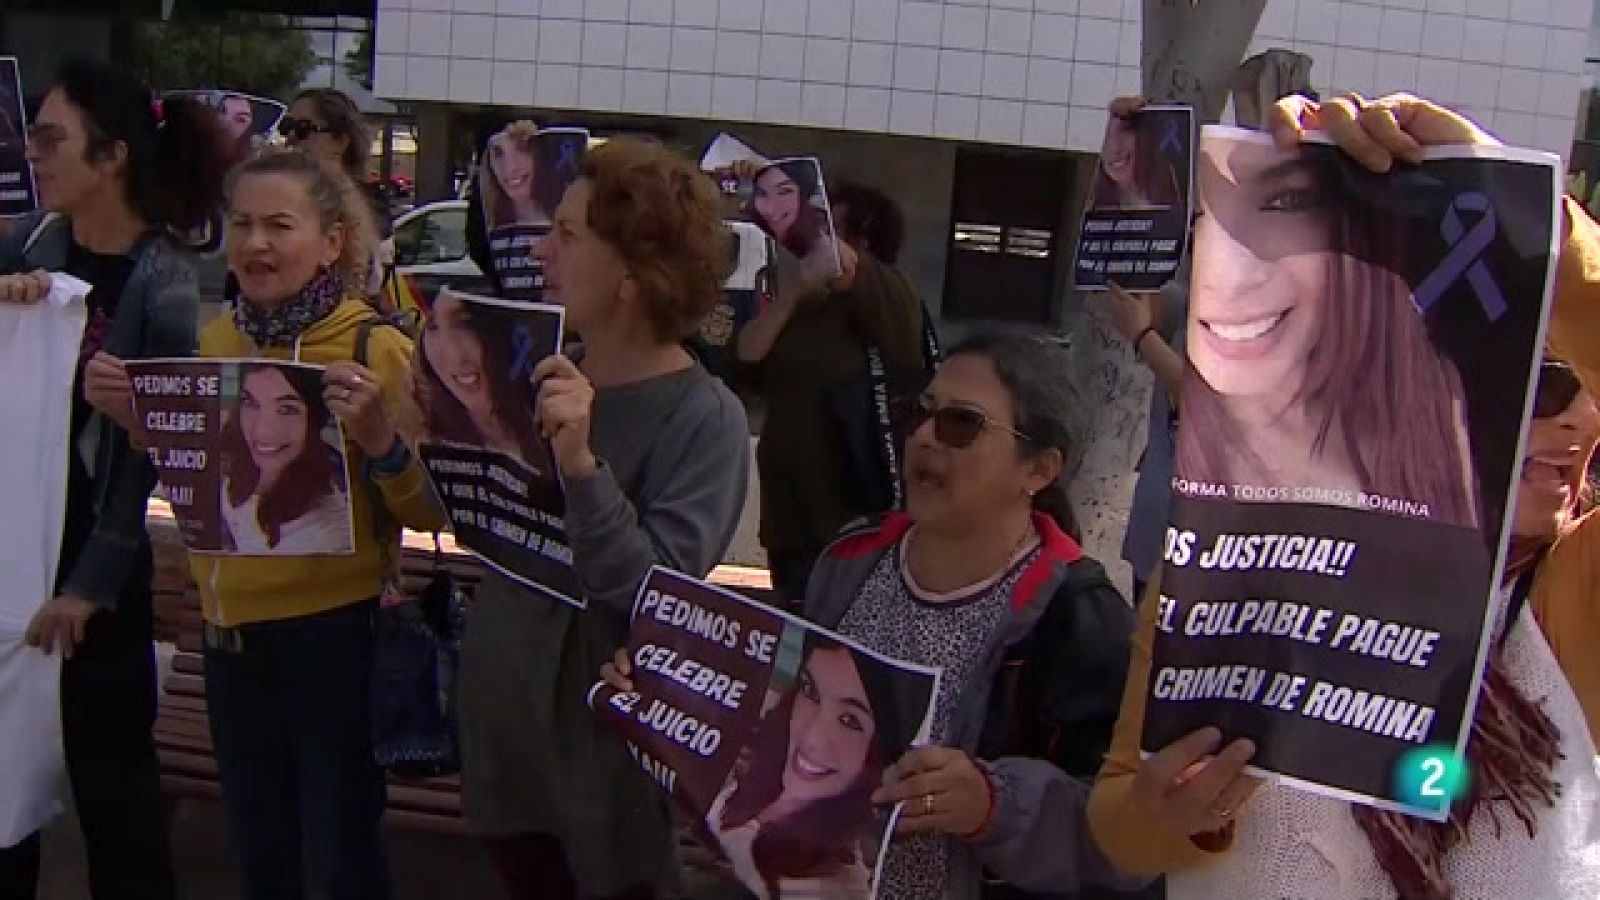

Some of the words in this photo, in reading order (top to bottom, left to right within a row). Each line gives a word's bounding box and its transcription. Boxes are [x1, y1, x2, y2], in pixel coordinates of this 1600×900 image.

[133, 374, 191, 395] PEDIMOS
[197, 376, 219, 396] SE
[147, 411, 206, 432] CELEBRE
[164, 449, 207, 470] JUICIO
[1232, 485, 1288, 500] TODOS
[1294, 487, 1353, 503] SOMOS
[1357, 492, 1430, 517] ROMINA
[1200, 533, 1356, 577] JUSTICIA!!
[640, 589, 741, 649] PEDIMOS
[744, 629, 778, 663] SE
[1185, 601, 1333, 643] CULPABLE
[1330, 614, 1440, 667] PAGUE
[634, 644, 748, 709] CELEBRE
[637, 699, 721, 756] JUICIO
[1154, 665, 1266, 701] CRIMEN
[1262, 672, 1306, 711] DE
[1302, 681, 1436, 744] ROMINA
